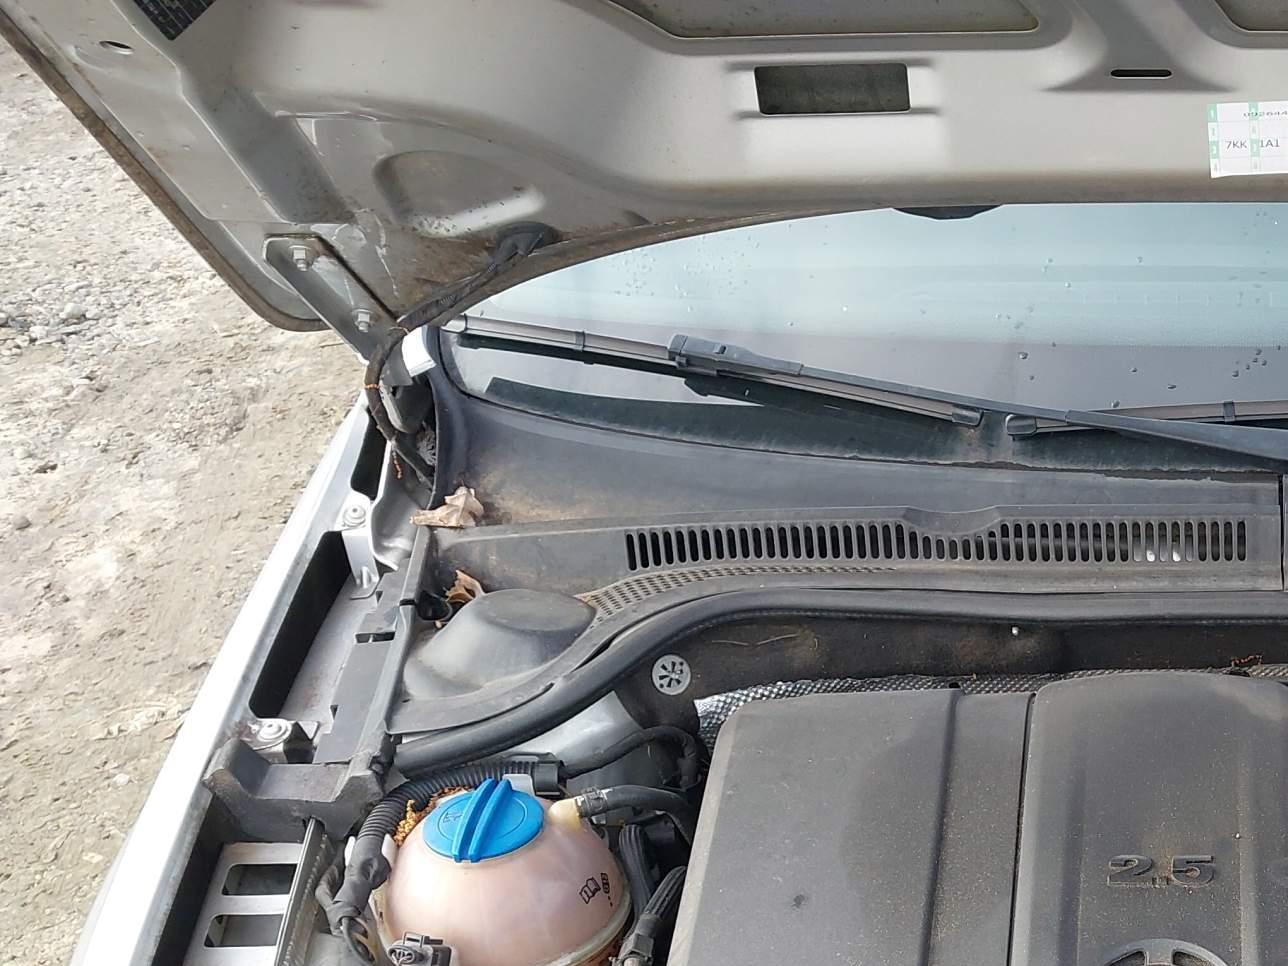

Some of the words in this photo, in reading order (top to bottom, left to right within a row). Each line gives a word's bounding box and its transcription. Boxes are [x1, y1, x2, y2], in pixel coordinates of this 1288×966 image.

[1225, 140, 1248, 150] 7KK
[1260, 139, 1280, 148] 1A1
[1107, 855, 1216, 887] 2.5
